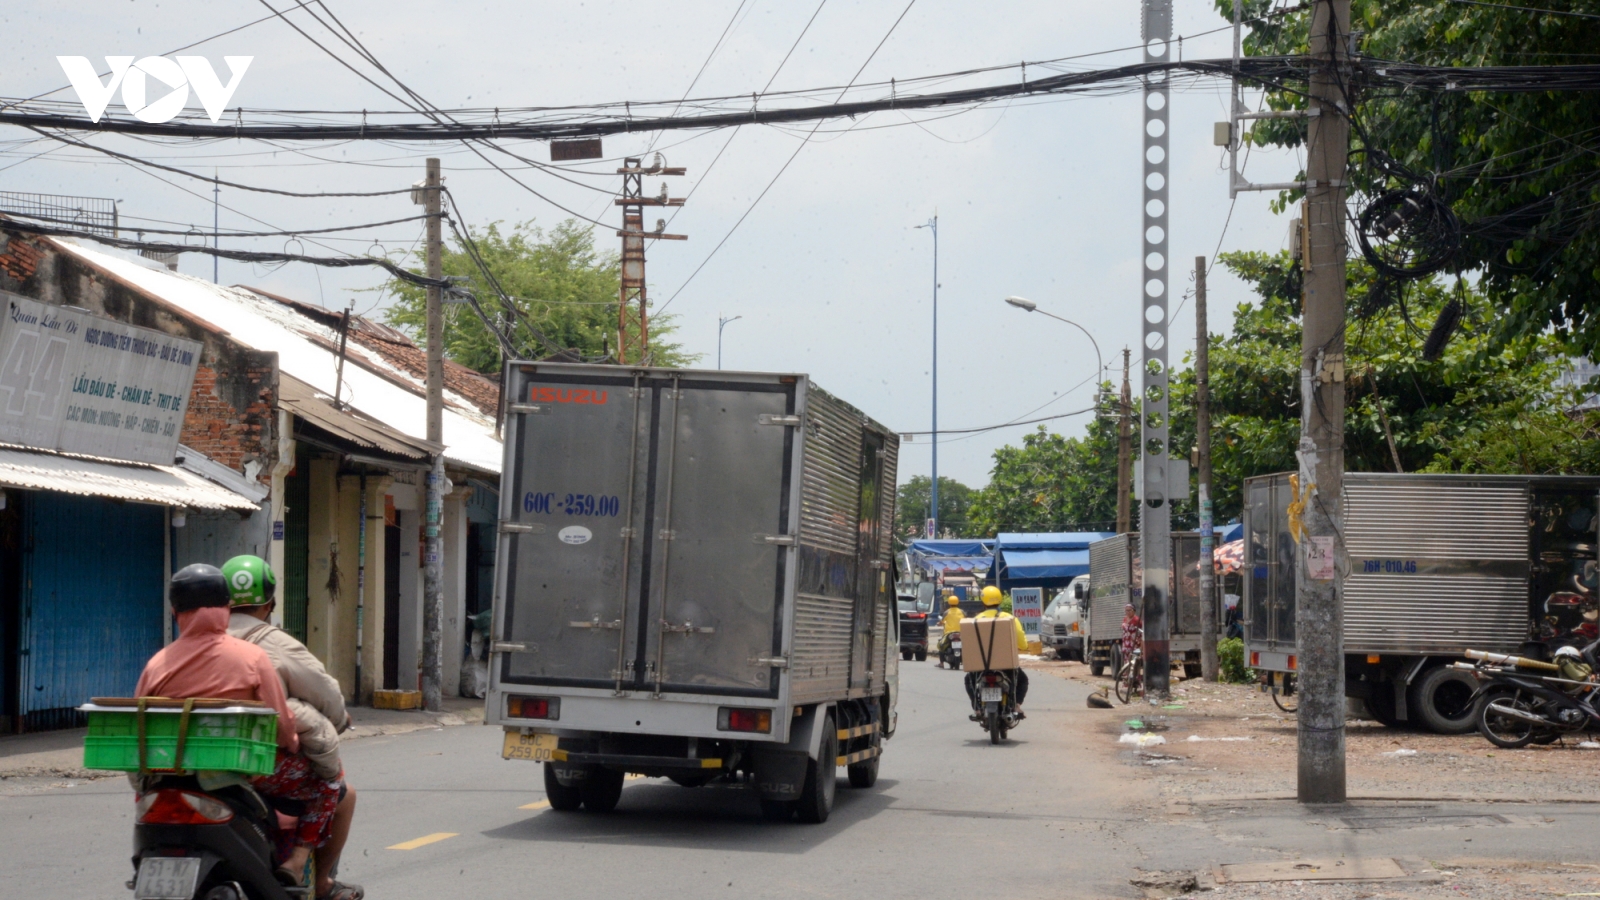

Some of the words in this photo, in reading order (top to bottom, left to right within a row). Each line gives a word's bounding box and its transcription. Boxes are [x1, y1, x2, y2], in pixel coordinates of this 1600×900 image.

[0, 329, 70, 420] 44
[122, 385, 142, 404] CHÂN
[157, 393, 172, 412] THỊT
[531, 386, 608, 405] ISUZU
[1363, 560, 1417, 573] 76H-010.46
[508, 746, 550, 760] 259.00
